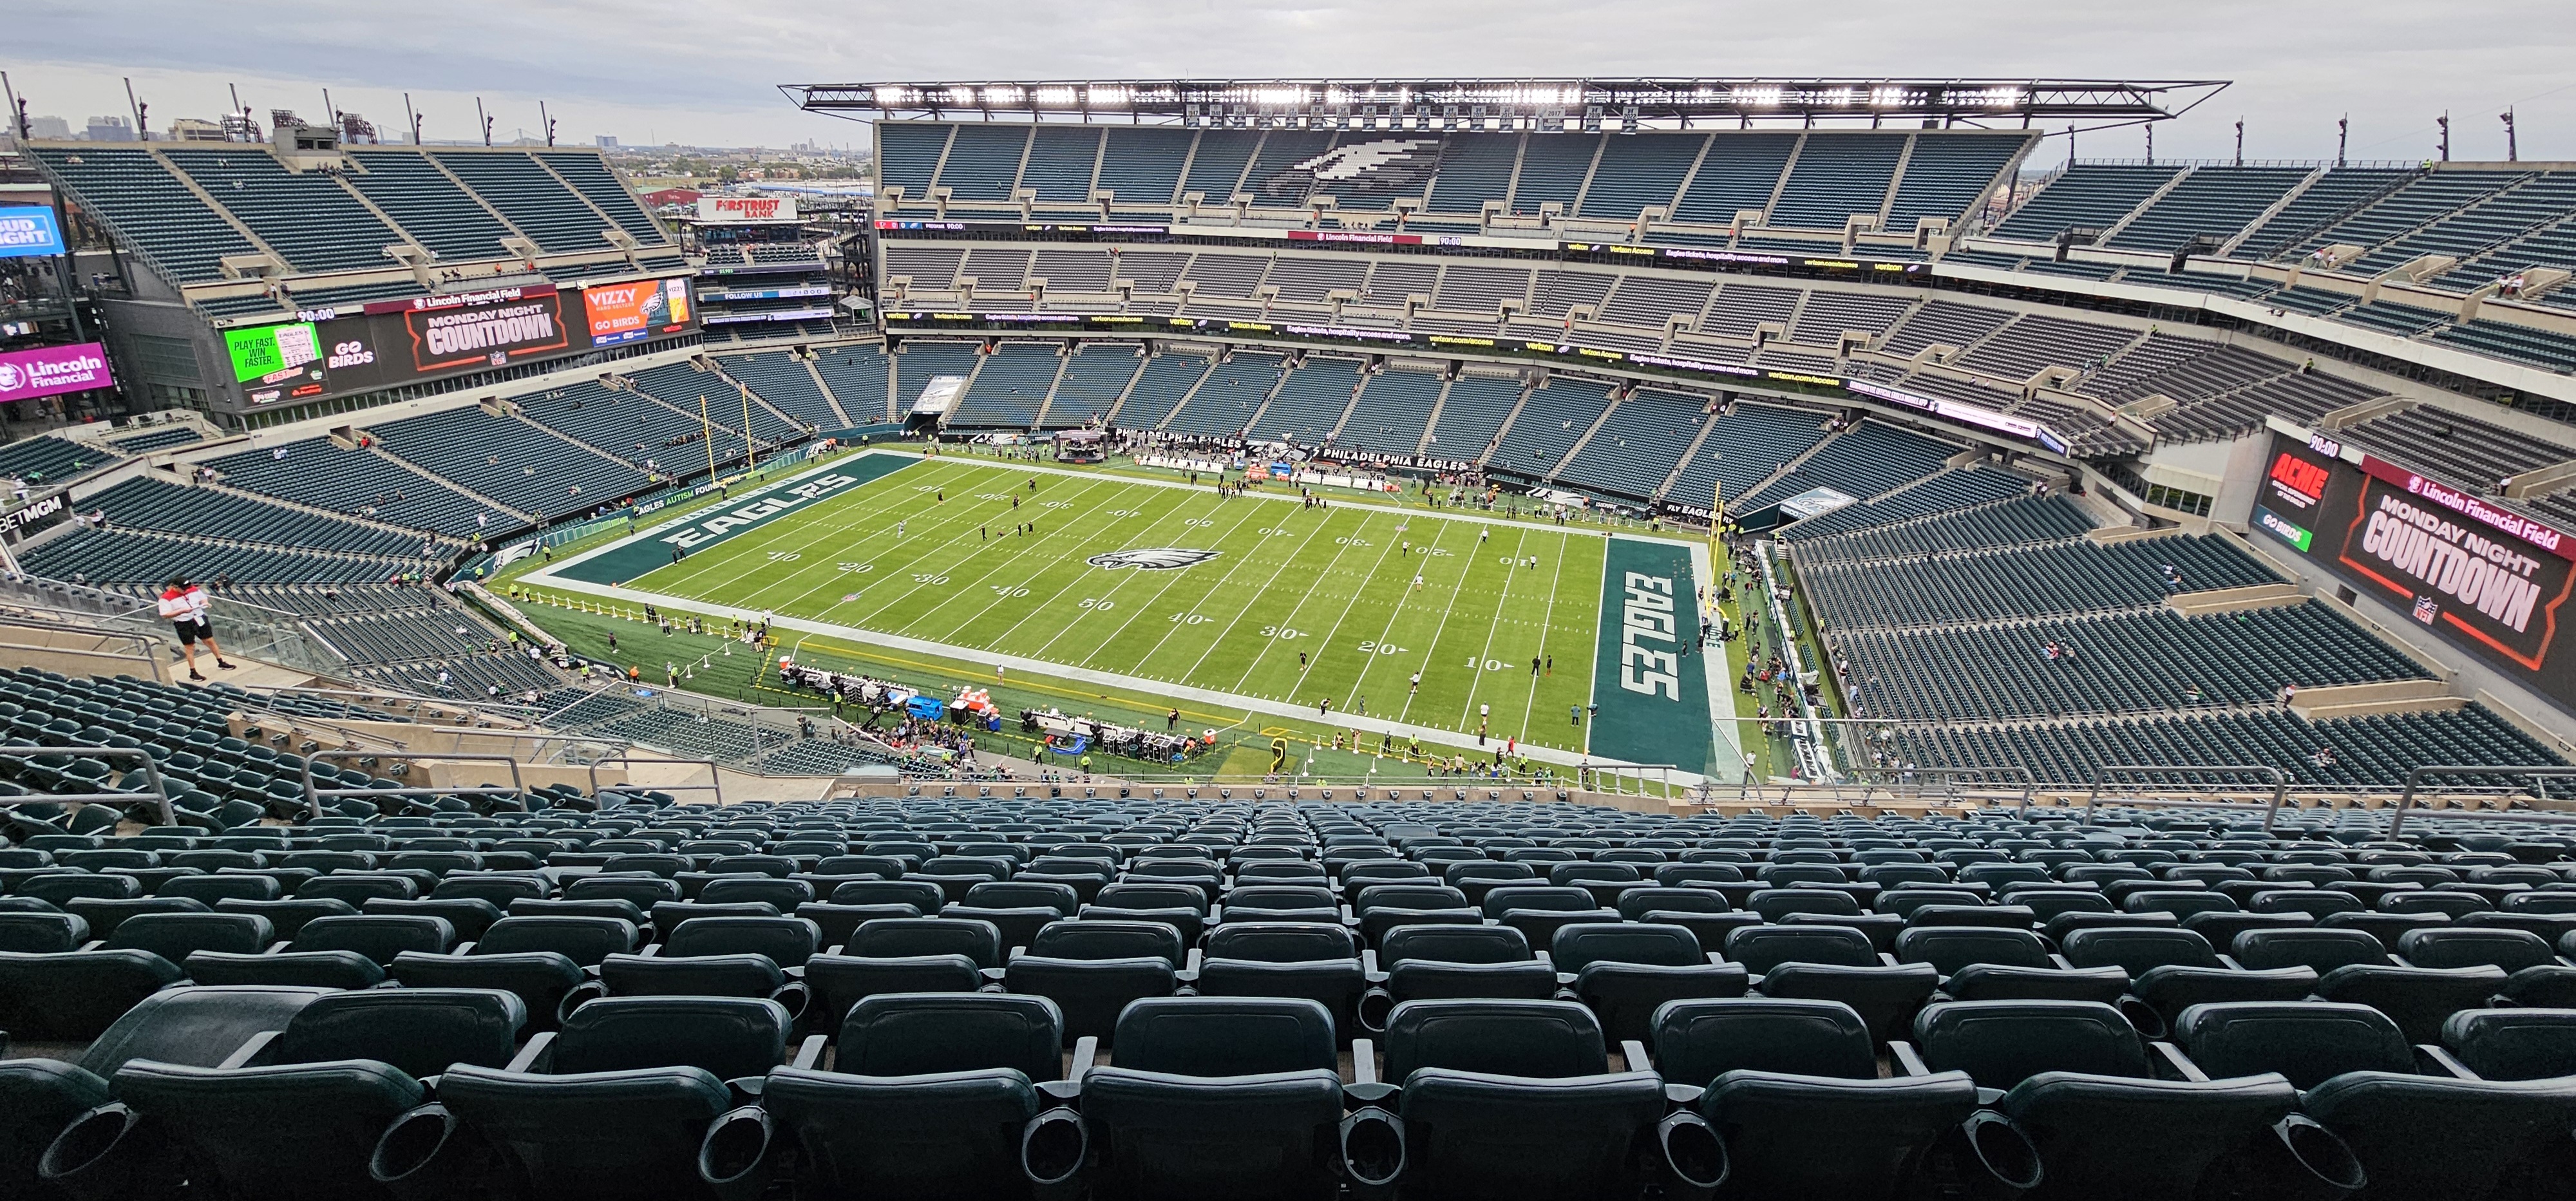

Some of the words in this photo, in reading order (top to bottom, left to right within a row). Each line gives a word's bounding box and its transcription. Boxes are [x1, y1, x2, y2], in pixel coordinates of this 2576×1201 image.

[744, 210, 774, 218] BANK
[1349, 234, 1377, 242] Financial
[426, 294, 461, 307] Lincoln
[461, 290, 501, 303] Financial
[501, 288, 521, 299] Field
[588, 288, 638, 306] VIZZY
[612, 302, 635, 310] SELTZER
[297, 308, 335, 323] 90:00
[428, 310, 497, 328] MONDAY
[498, 304, 544, 319] NIGHT
[1169, 317, 1193, 326] verizon
[594, 321, 611, 330] GO
[612, 316, 640, 327] BIRDS
[426, 313, 554, 355] COUNTDOWN
[1307, 326, 1329, 335] tickets,
[1329, 328, 1360, 337] hospitality
[234, 339, 254, 351] PLAY
[255, 337, 276, 347] FAST.
[335, 341, 362, 355] GO
[1429, 336, 1493, 346] verizon.com/access
[1526, 342, 1554, 352] verizon
[249, 347, 265, 357] WIN
[1579, 347, 1600, 356] Verizon
[1600, 350, 1622, 359] Access
[25, 355, 102, 377] Lincoln
[245, 355, 275, 368] FASTER.
[328, 350, 374, 369] BIRDS
[1629, 354, 1650, 363] Eagles
[1650, 356, 1672, 366] tickets,
[1672, 359, 1704, 370] hospitality
[30, 370, 95, 388] Financial
[1768, 372, 1840, 386] verizon.com/access
[2309, 435, 2339, 458] 90:00
[1323, 449, 1412, 466] PHILADELPHIA
[1417, 458, 1467, 471] EAGLES
[2271, 453, 2329, 499] ACME
[918, 484, 946, 493] 10
[637, 500, 665, 515] AGLES
[666, 489, 694, 506] AUTISM
[982, 492, 1010, 501] 20
[658, 473, 858, 548] EAGLES
[679, 503, 726, 521] TAKES
[730, 491, 755, 504] ALL
[1045, 500, 1074, 509] 30
[0, 495, 62, 533] BETMGM
[1114, 509, 1141, 518] 40
[1667, 504, 1680, 513] FLY
[1681, 506, 1721, 520] EAGLES
[1723, 516, 1734, 524] FLY
[2421, 481, 2465, 511] Lincoln
[2464, 499, 2525, 536] Financial
[2522, 523, 2561, 551] Field
[1184, 518, 1214, 527] 50
[2263, 514, 2278, 528] GO
[2276, 520, 2302, 542] BIRDS
[1257, 527, 1288, 536] 40
[2380, 495, 2468, 544] MONDAY
[2464, 532, 2541, 578] NIGHT
[1334, 536, 1366, 547] 30
[772, 551, 802, 563] 10
[1415, 547, 1448, 556] 20
[842, 562, 875, 574] 20
[1499, 556, 1528, 567] 10
[2362, 511, 2541, 633] COUNTDOWN
[916, 573, 951, 586] 30
[997, 585, 1031, 598] 40
[1078, 598, 1115, 612] 50
[1167, 612, 1205, 626] 40
[2414, 607, 2434, 625] NFL
[1259, 625, 1298, 640] 30
[1620, 571, 1680, 703] EAGLES
[1356, 640, 1396, 655] 20
[1464, 656, 1502, 672] 10
